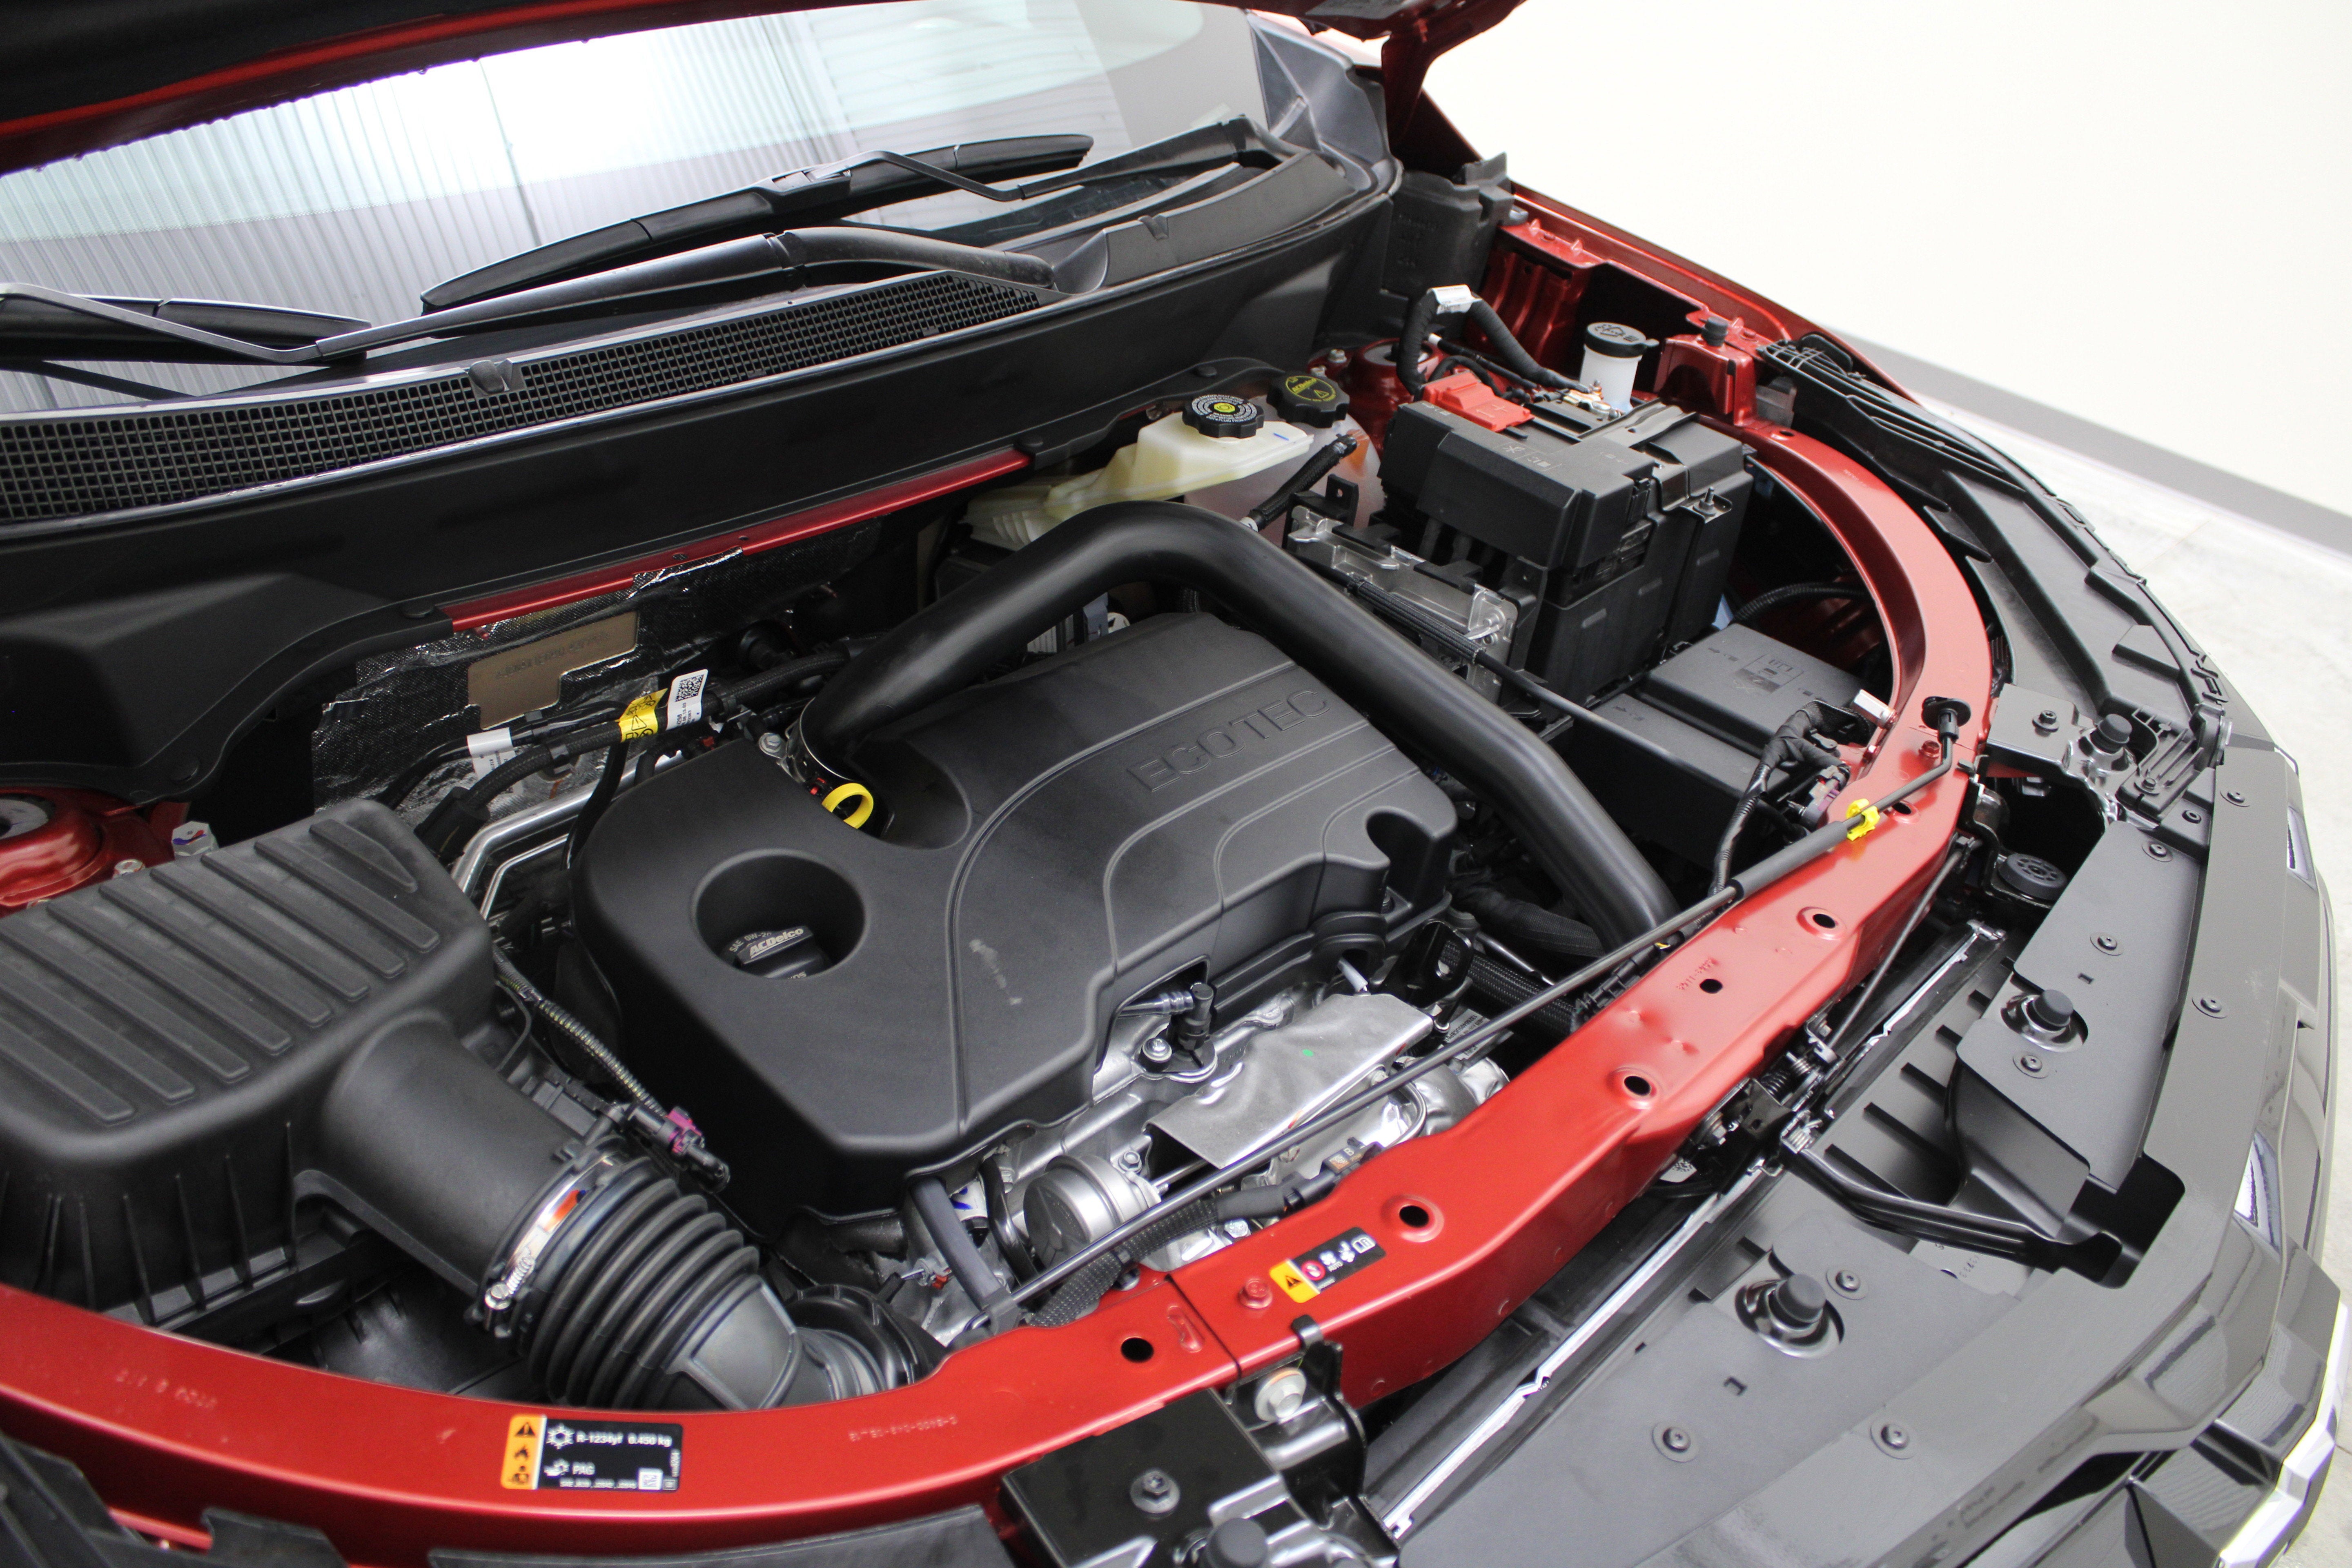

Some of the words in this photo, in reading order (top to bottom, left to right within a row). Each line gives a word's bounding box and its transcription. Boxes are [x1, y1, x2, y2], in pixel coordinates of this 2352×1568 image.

[1126, 690, 1331, 791] ECOTEC
[729, 940, 744, 952] SAE
[750, 928, 804, 957] ACDelco
[1328, 1261, 1343, 1272] AUTO
[576, 1430, 623, 1446] R-1234yf
[628, 1432, 657, 1446] 0.450
[657, 1434, 673, 1448] kg
[572, 1461, 595, 1476] PAG
